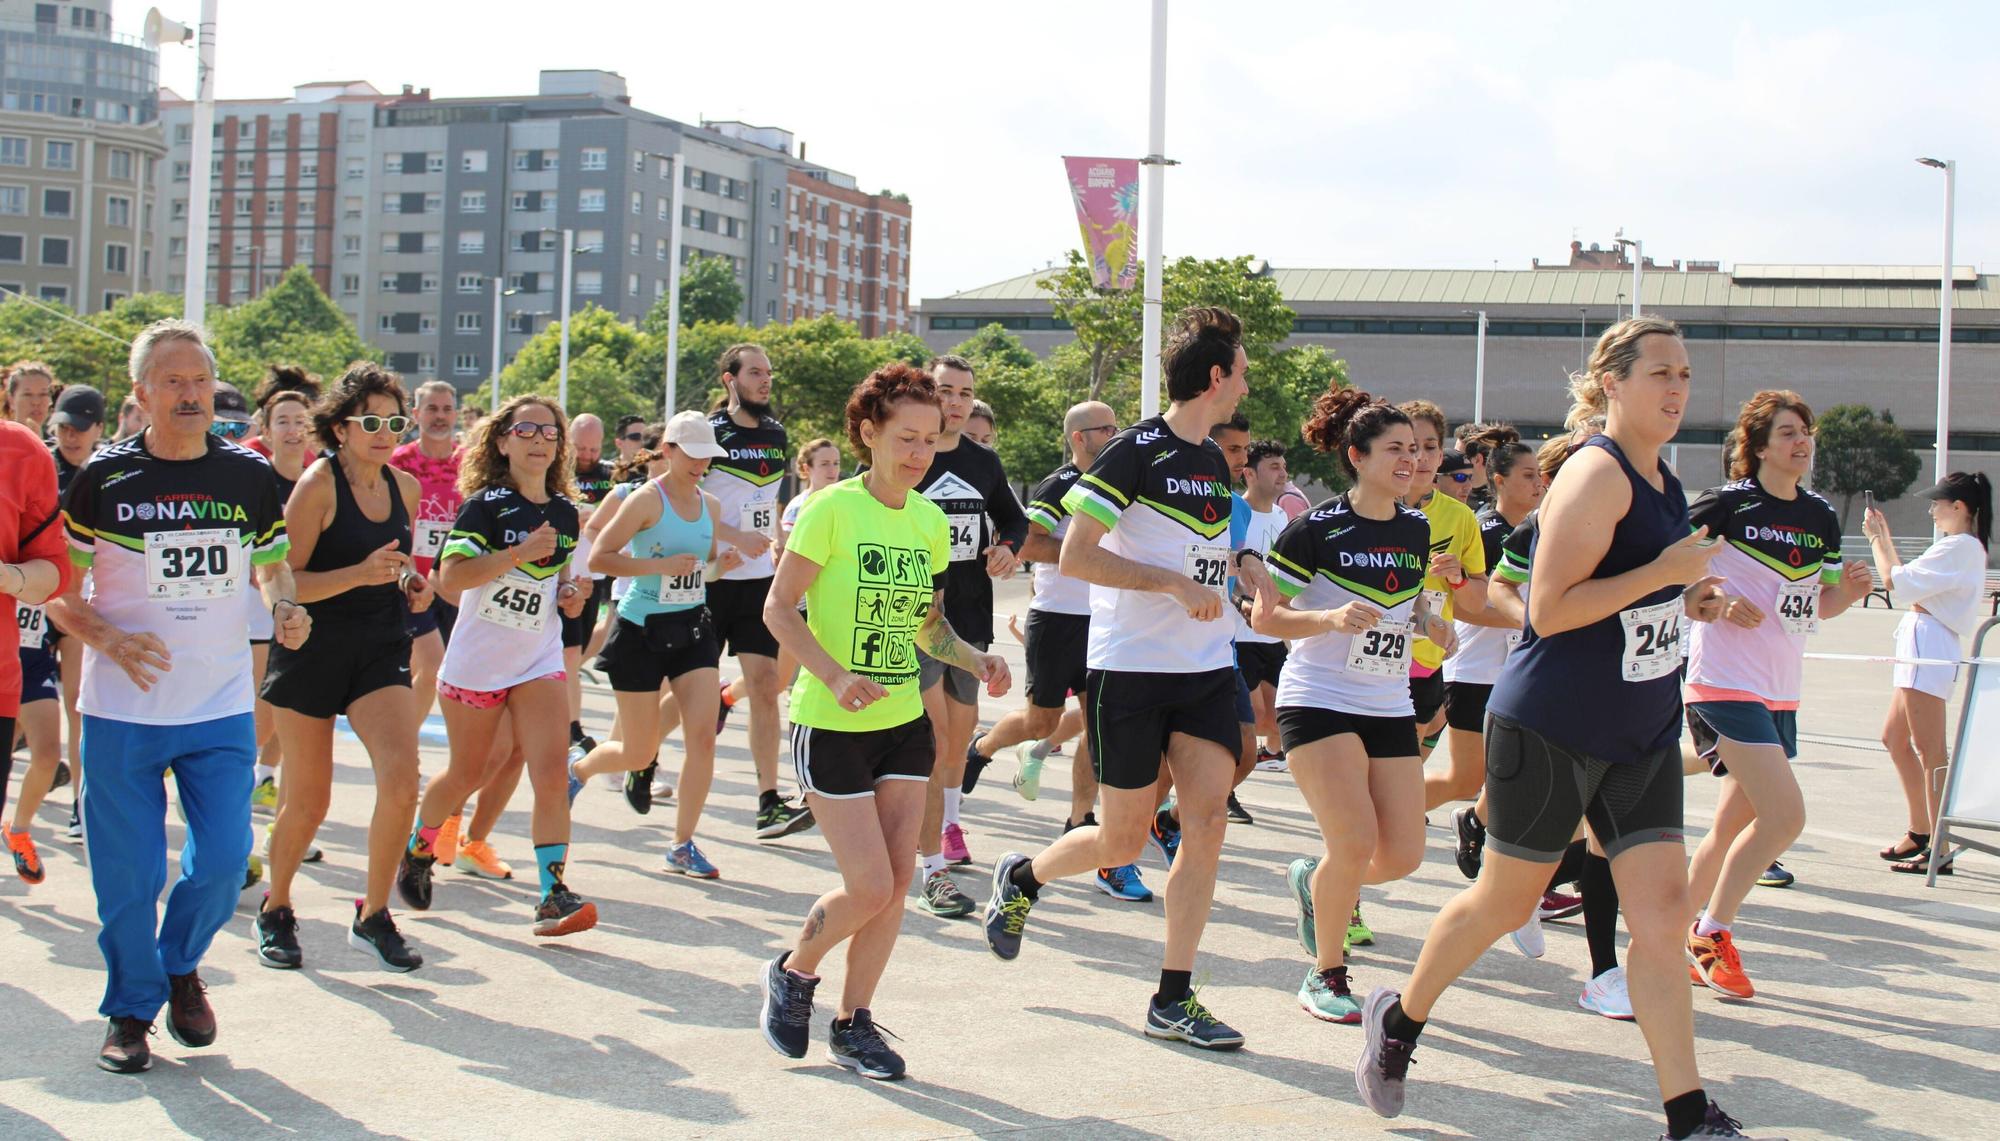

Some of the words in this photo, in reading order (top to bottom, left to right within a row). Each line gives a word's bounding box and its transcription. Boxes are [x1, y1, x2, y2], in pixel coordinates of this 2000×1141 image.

[117, 501, 248, 522] DONAVIDA
[753, 510, 770, 528] 65
[162, 545, 228, 578] 320
[1193, 558, 1227, 586] 328
[1339, 551, 1423, 571] DONAVIDA
[669, 570, 702, 590] 300
[492, 586, 541, 616] 458
[1780, 595, 1814, 618] 434
[1362, 630, 1406, 659] 329
[1635, 615, 1680, 657] 244
